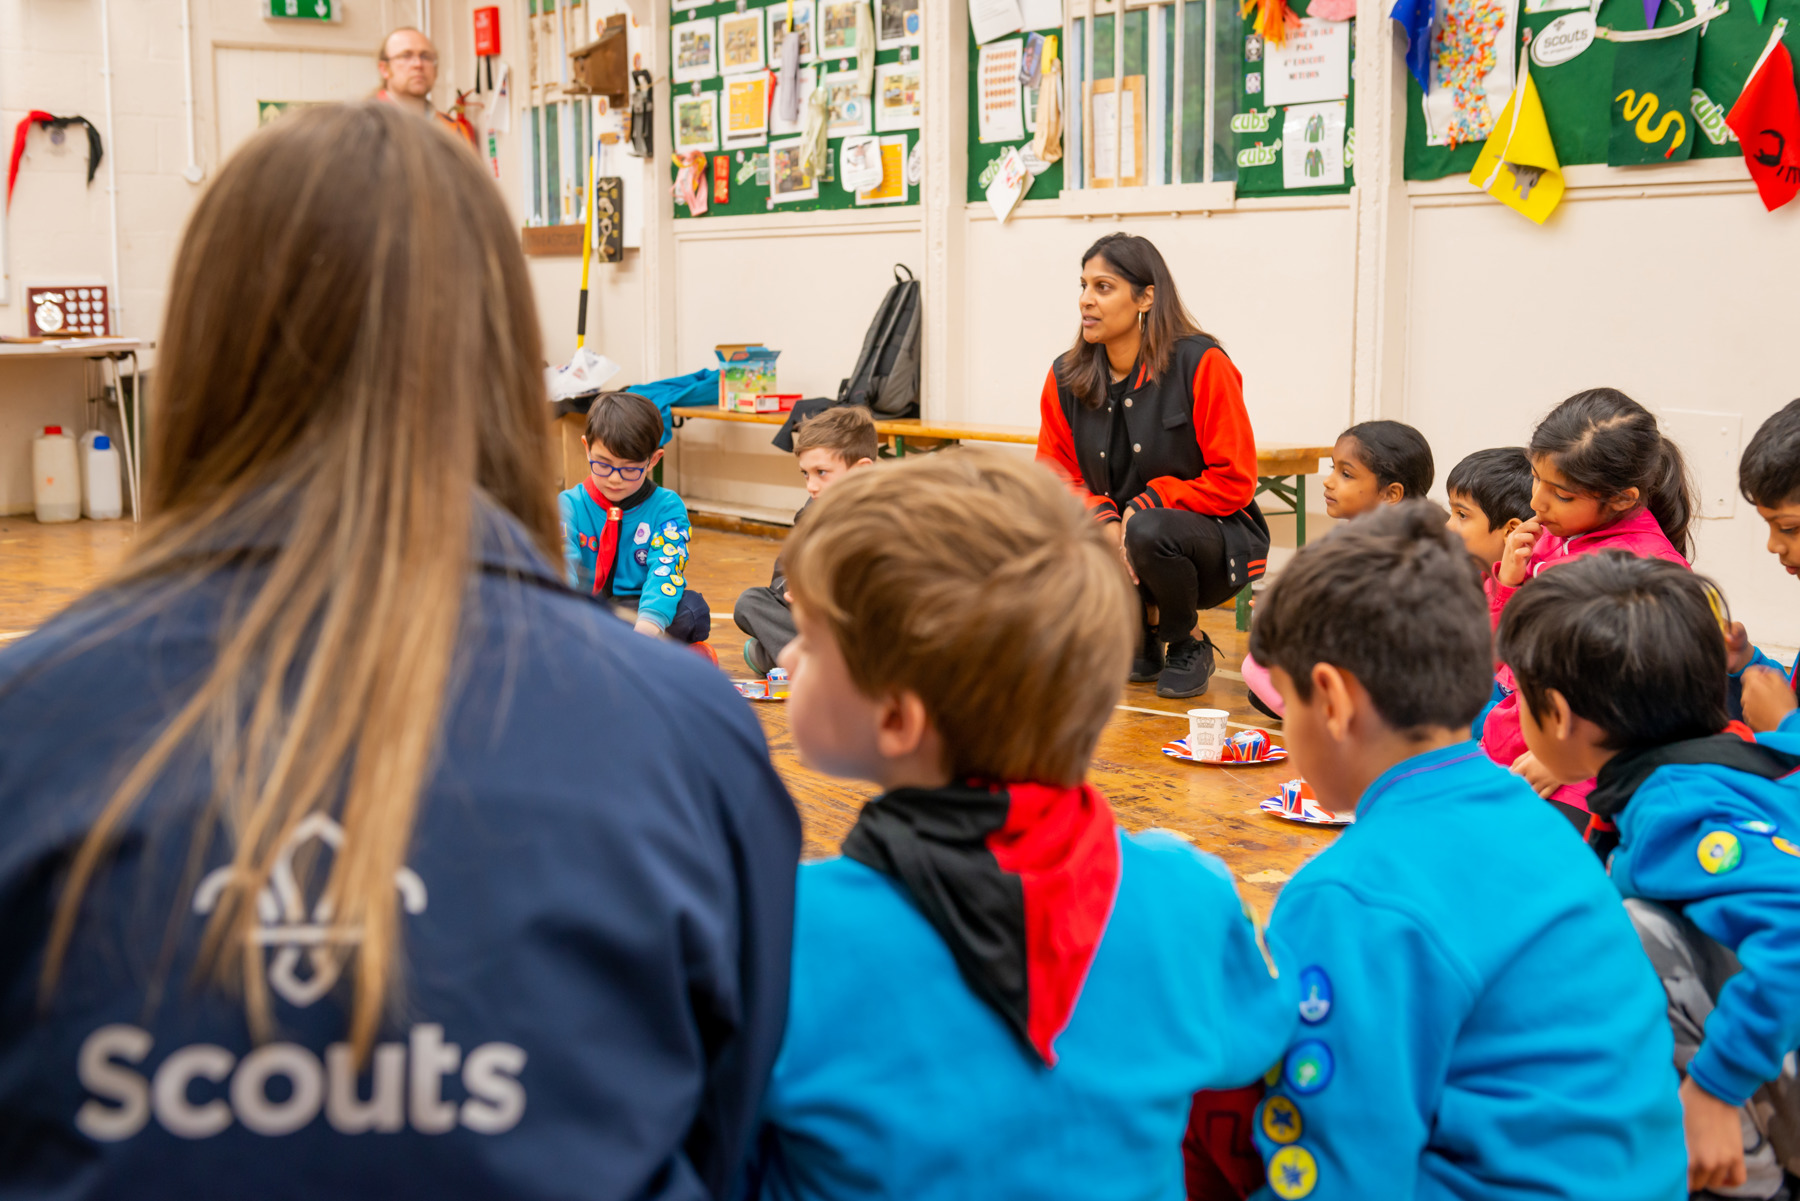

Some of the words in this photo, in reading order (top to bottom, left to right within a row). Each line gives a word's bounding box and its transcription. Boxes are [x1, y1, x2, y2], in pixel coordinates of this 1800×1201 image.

[1543, 29, 1588, 49] scouts
[1231, 112, 1269, 131] cubs
[1238, 146, 1276, 166] cubs
[75, 1022, 528, 1142] Scouts
